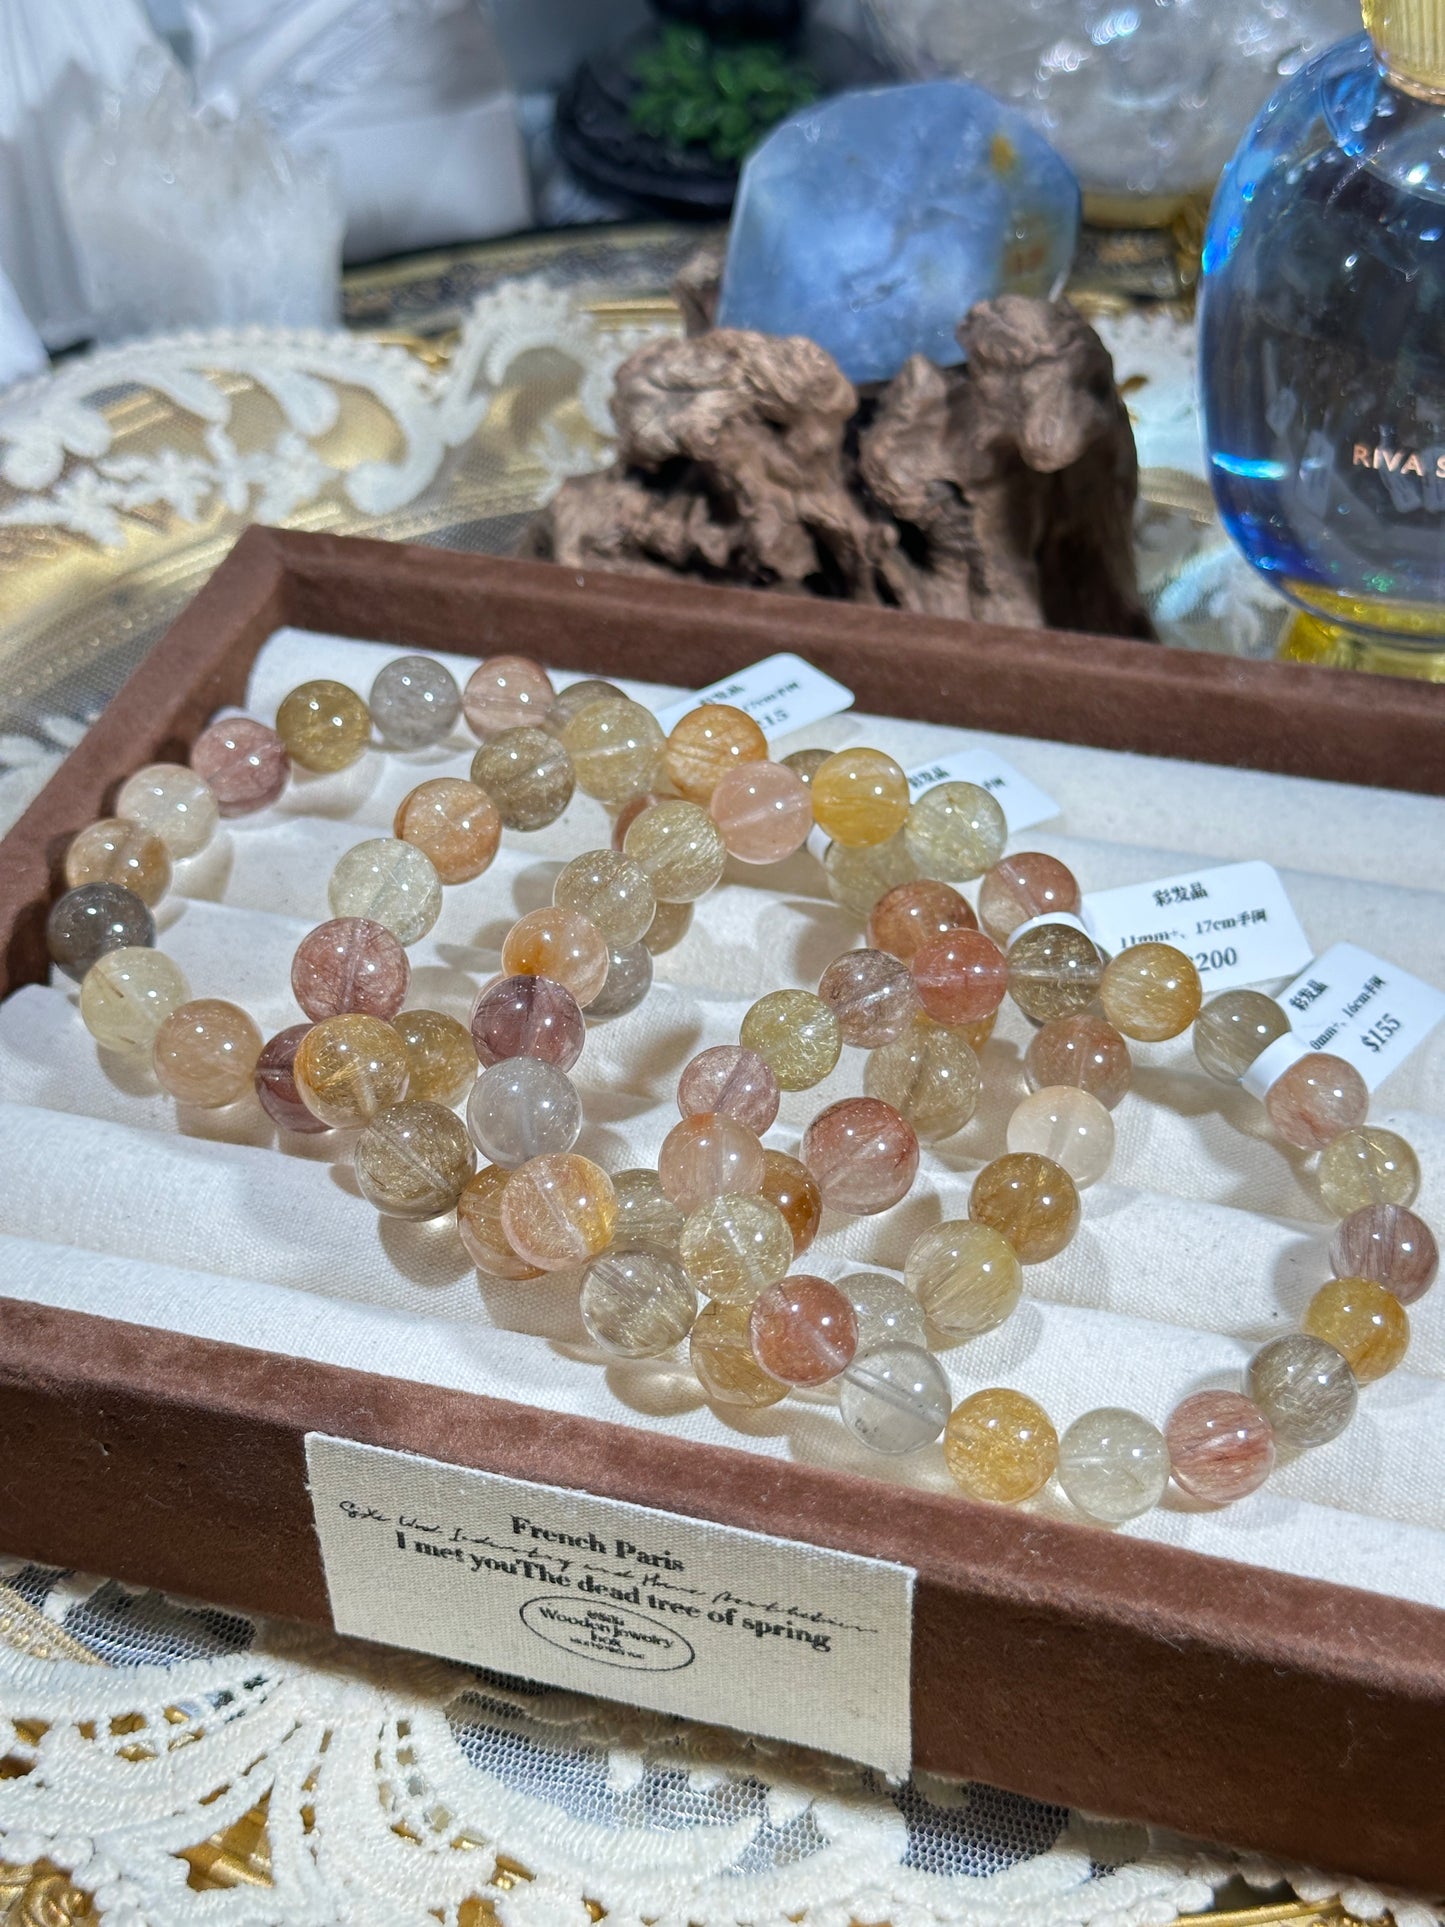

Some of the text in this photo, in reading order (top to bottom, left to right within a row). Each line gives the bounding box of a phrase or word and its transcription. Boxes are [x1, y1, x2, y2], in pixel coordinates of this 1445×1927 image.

[1353, 444, 1424, 477] RIVA
[1153, 881, 1208, 907] 彩发晶
[1189, 947, 1238, 972] 200
[1289, 979, 1328, 1011] 彩发晶
[1361, 1013, 1401, 1053] $155
[511, 1515, 685, 1571] French Paris
[396, 1530, 406, 1549] I
[414, 1541, 464, 1562] met
[578, 1574, 640, 1604] dead
[648, 1594, 701, 1618] tree
[707, 1608, 737, 1625] of
[742, 1616, 831, 1652] spring
